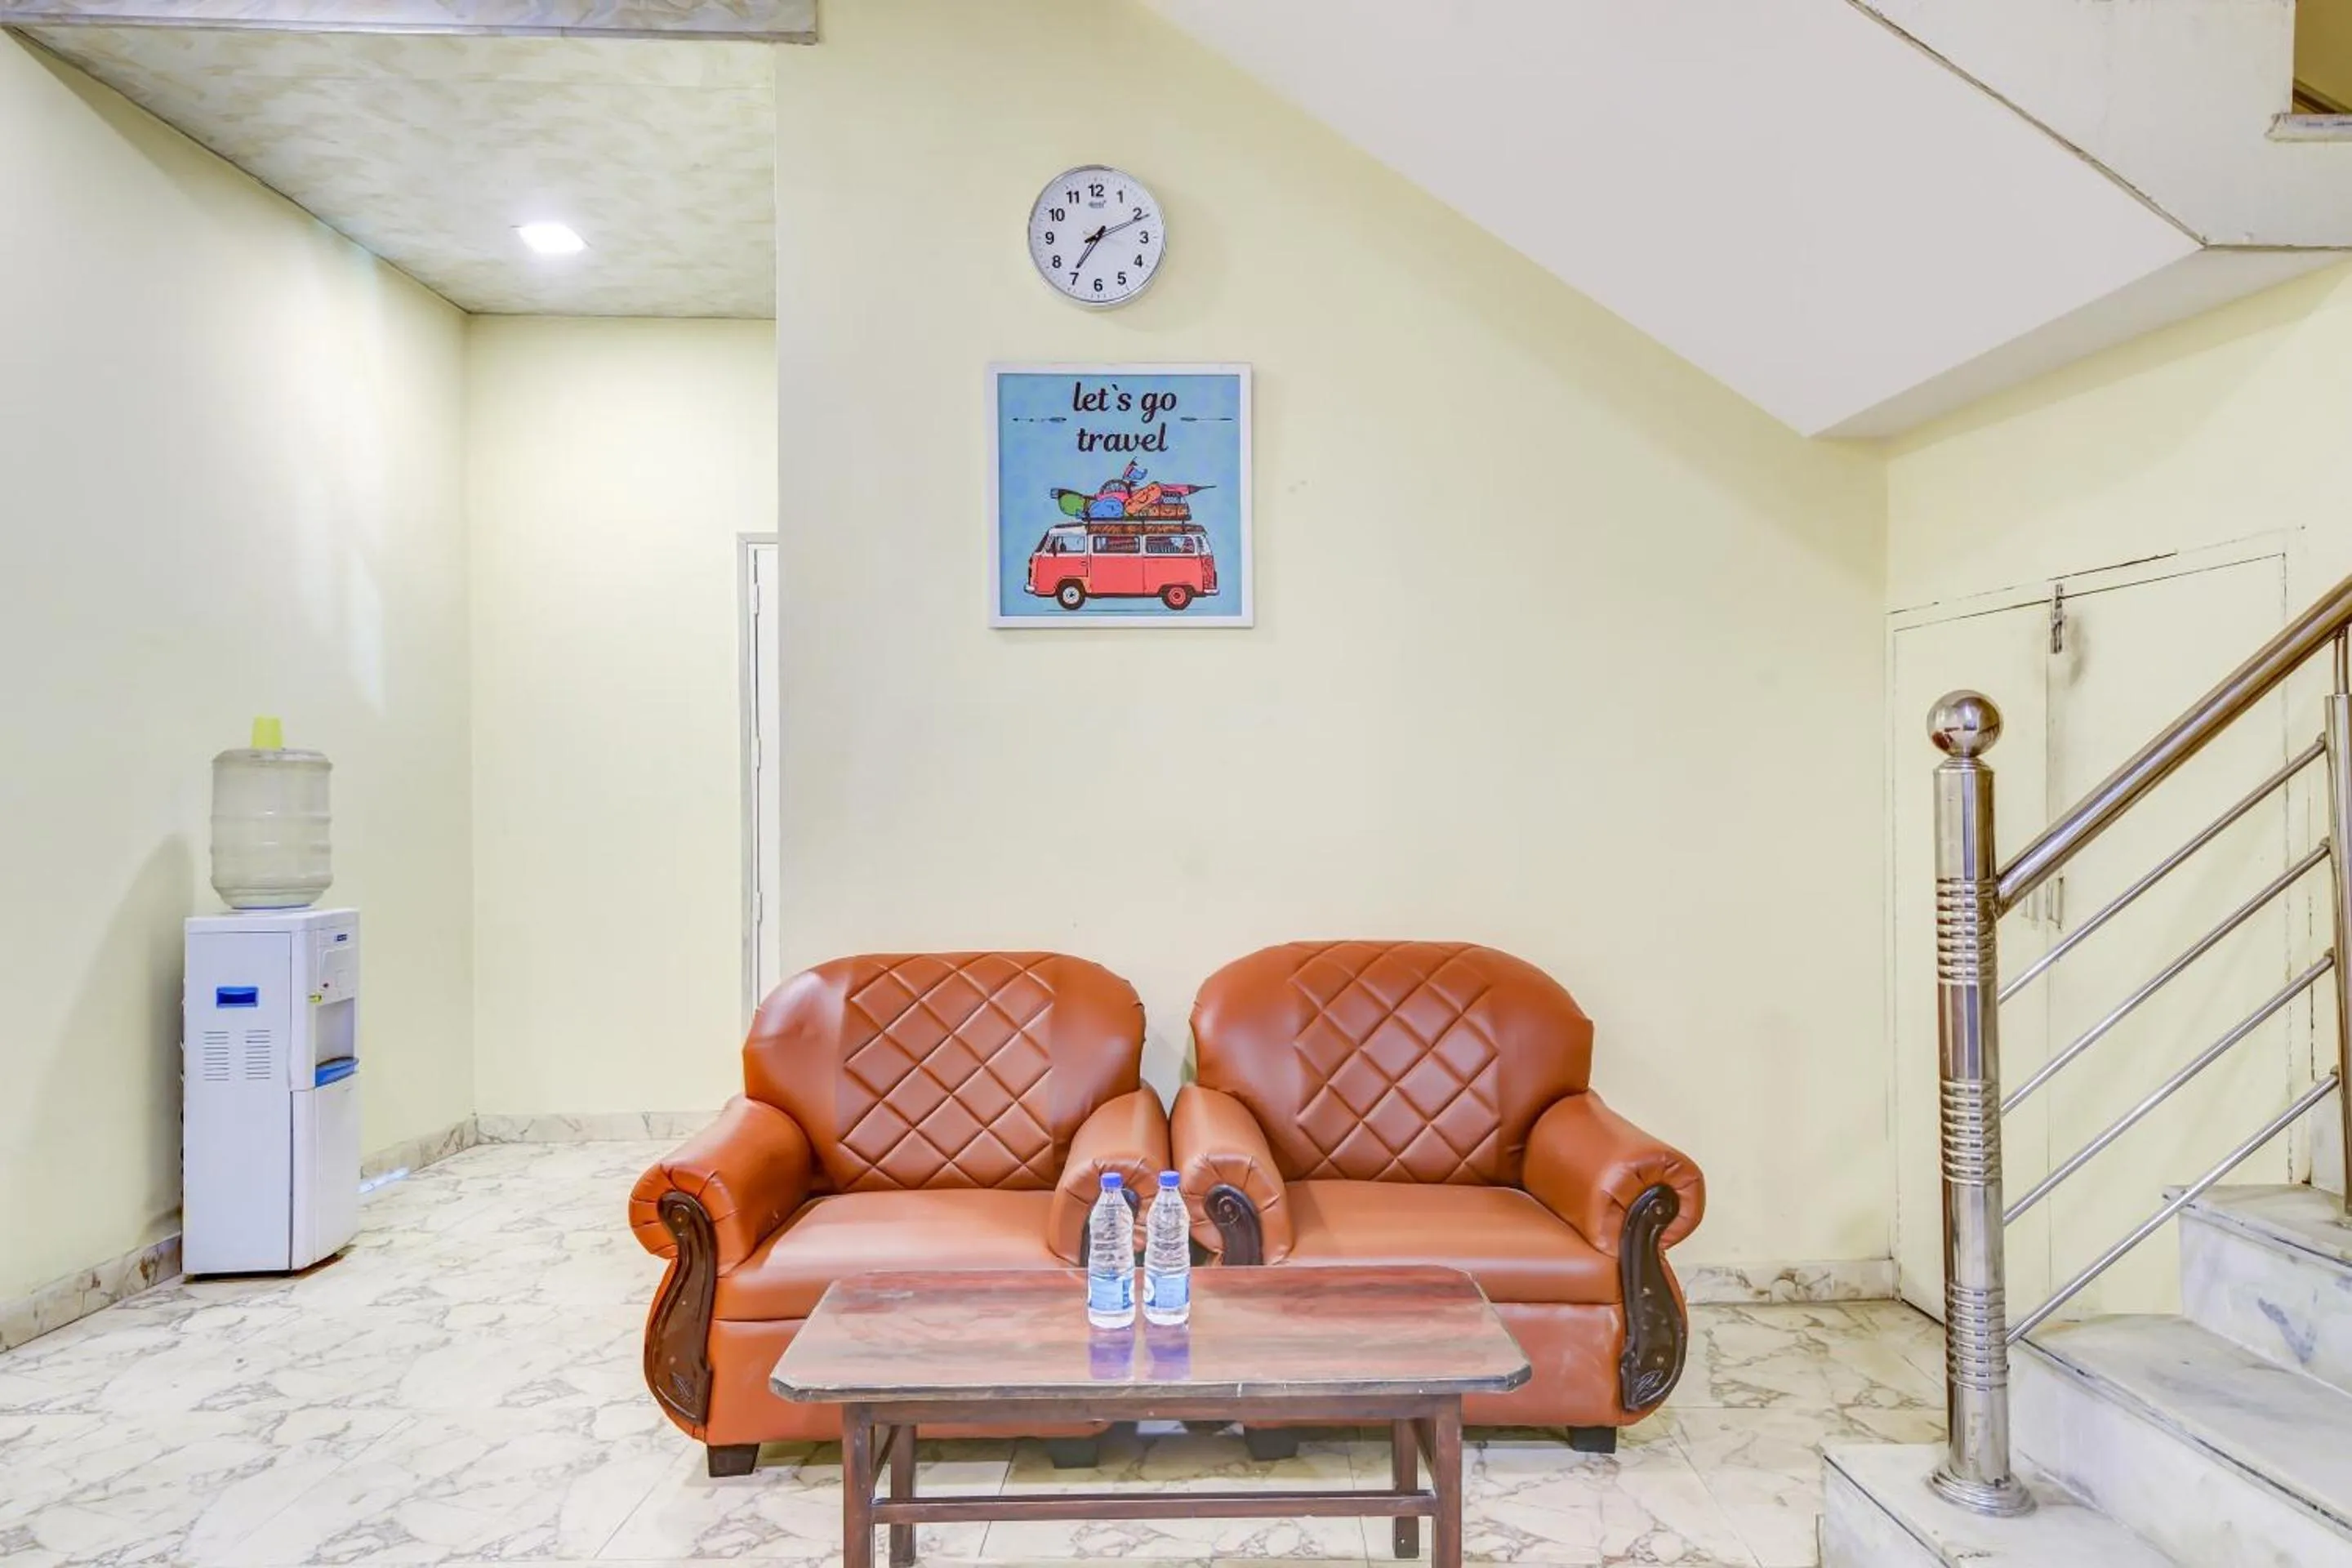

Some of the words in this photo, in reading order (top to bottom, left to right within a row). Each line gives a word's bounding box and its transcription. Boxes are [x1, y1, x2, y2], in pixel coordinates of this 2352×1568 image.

[1066, 190, 1080, 203] 11
[1088, 184, 1104, 197] 12
[1116, 189, 1124, 203] 1
[1049, 208, 1065, 221] 10
[1133, 207, 1143, 220] 2
[1045, 232, 1054, 244] 9
[1139, 231, 1149, 243] 3
[1052, 255, 1062, 268] 8
[1134, 254, 1143, 267] 4
[1069, 272, 1079, 285] 7
[1117, 271, 1126, 285] 5
[1094, 278, 1102, 292] 6
[1141, 390, 1177, 424] go
[1076, 422, 1169, 452] travel
